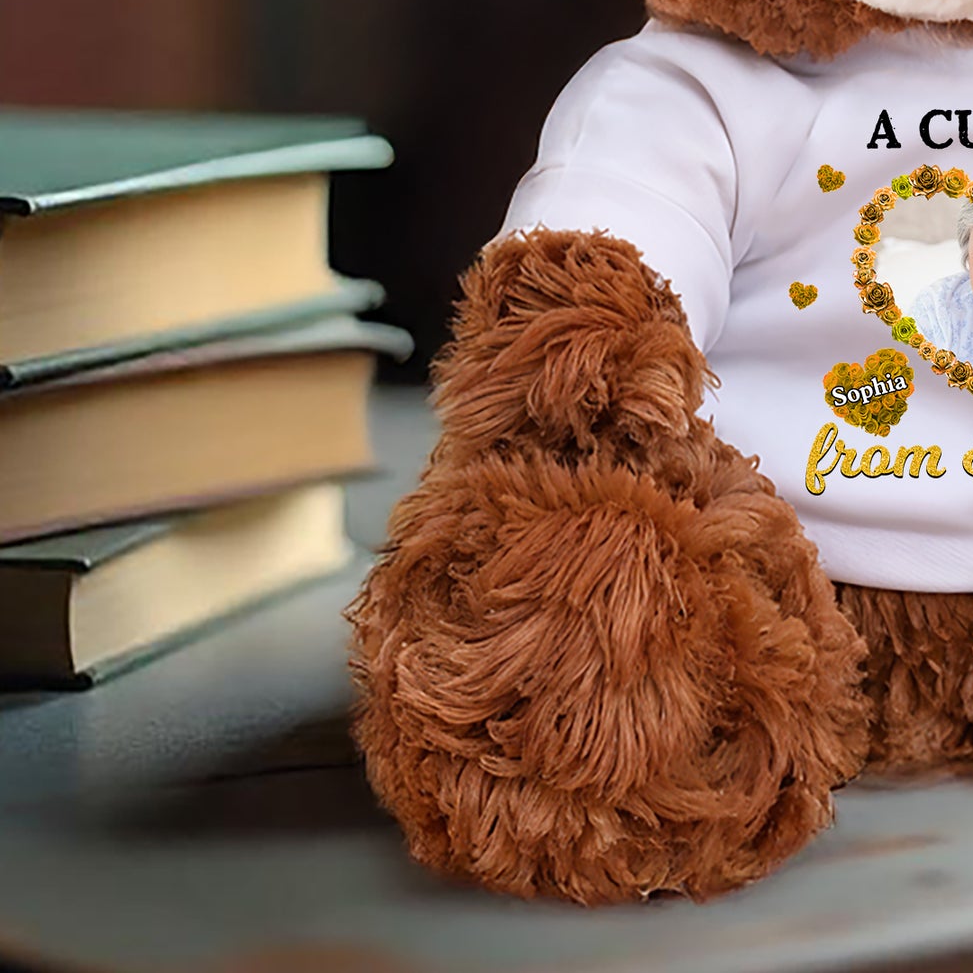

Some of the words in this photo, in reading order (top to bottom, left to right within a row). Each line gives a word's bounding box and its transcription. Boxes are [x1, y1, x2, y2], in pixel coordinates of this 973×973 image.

[867, 109, 901, 149] A
[832, 373, 907, 407] Sophia
[805, 421, 947, 495] from
